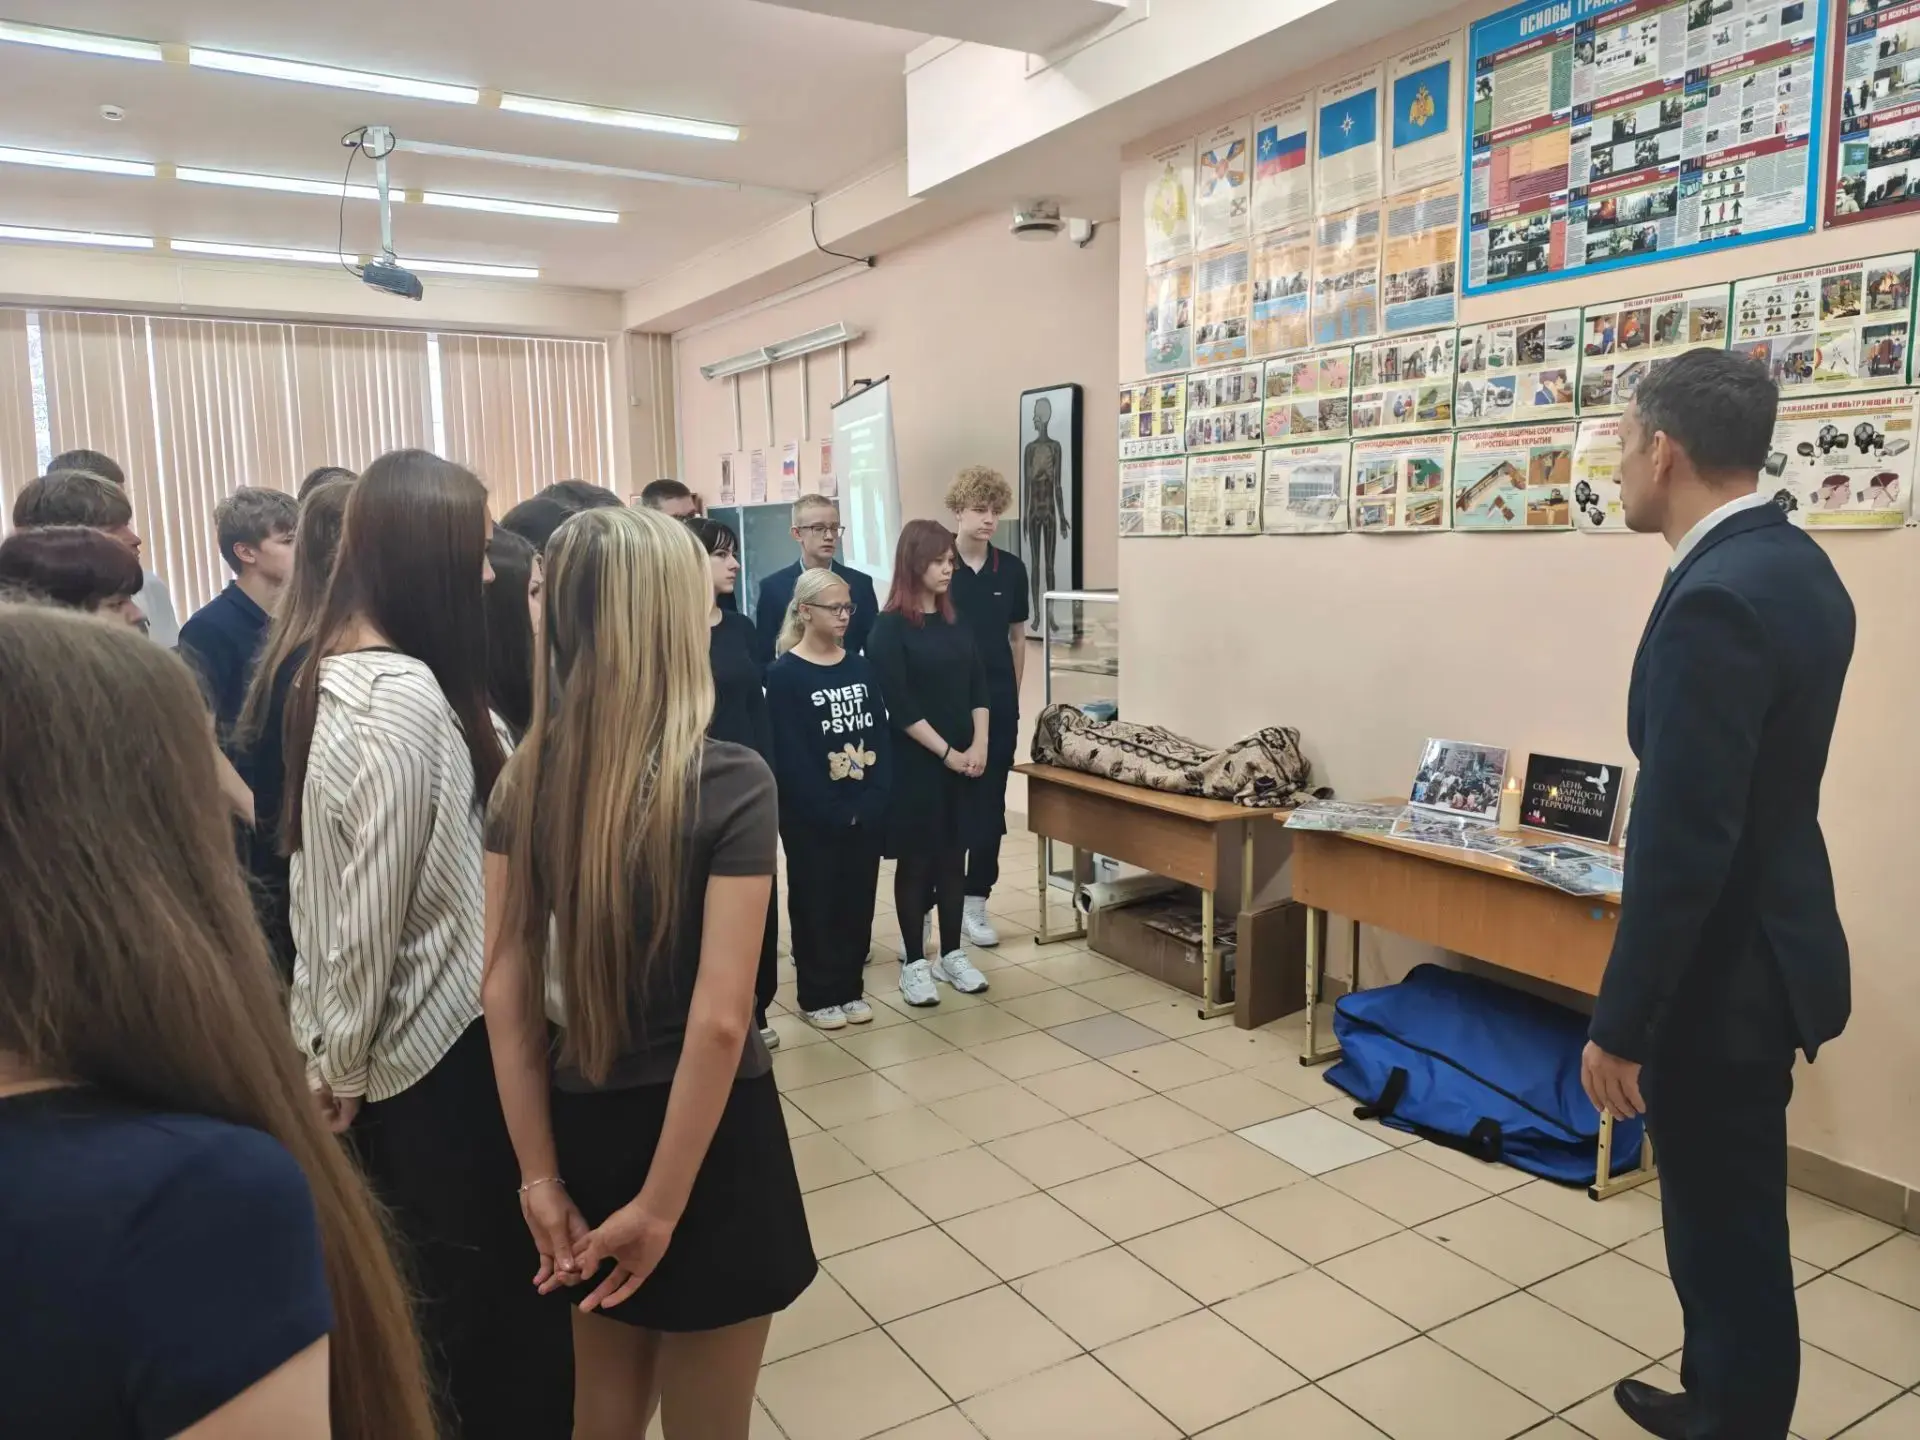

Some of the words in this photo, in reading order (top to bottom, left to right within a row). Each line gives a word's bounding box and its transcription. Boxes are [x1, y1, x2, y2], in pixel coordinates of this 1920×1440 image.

[1520, 0, 1571, 36] ОСНОВЫ
[831, 698, 863, 718] BUT
[1532, 782, 1606, 802] СОЛДАРНОСТИ
[1560, 779, 1582, 790] ДЕНЬ
[1532, 797, 1539, 805] С
[1540, 799, 1603, 817] ТЕРРОРИЗМОМ
